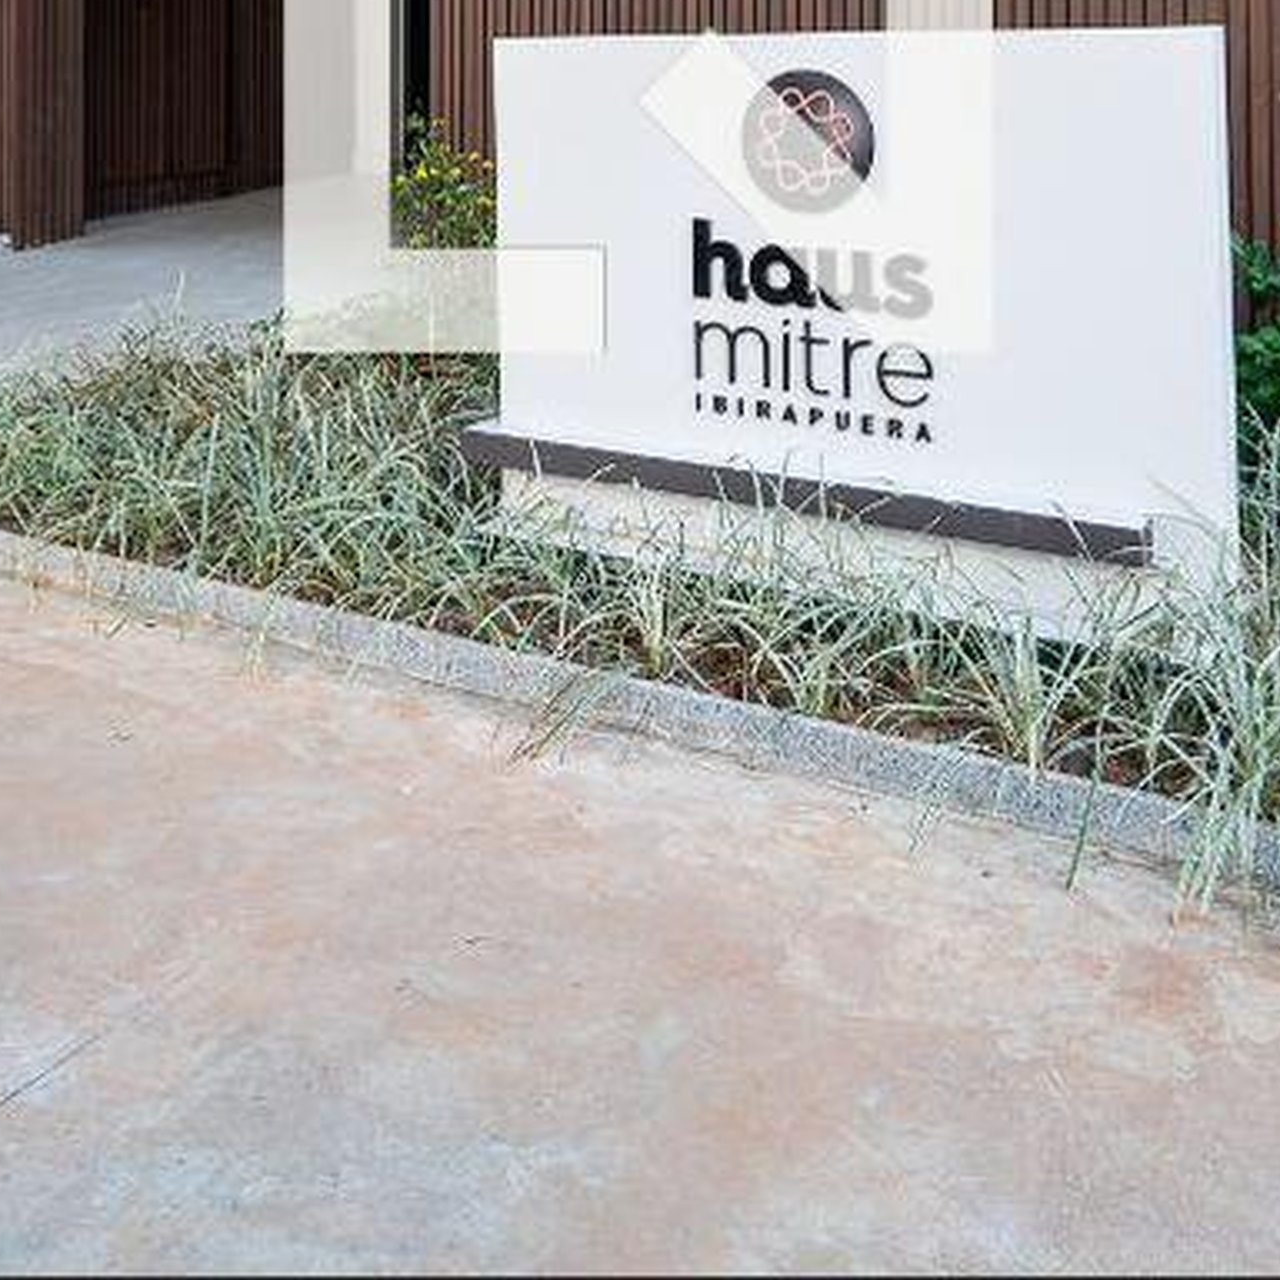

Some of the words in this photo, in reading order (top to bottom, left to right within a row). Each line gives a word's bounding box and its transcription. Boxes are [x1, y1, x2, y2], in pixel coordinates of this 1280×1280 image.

[692, 218, 934, 321] haus
[694, 320, 935, 408] mitre
[694, 392, 934, 444] IBIRAPUERA
